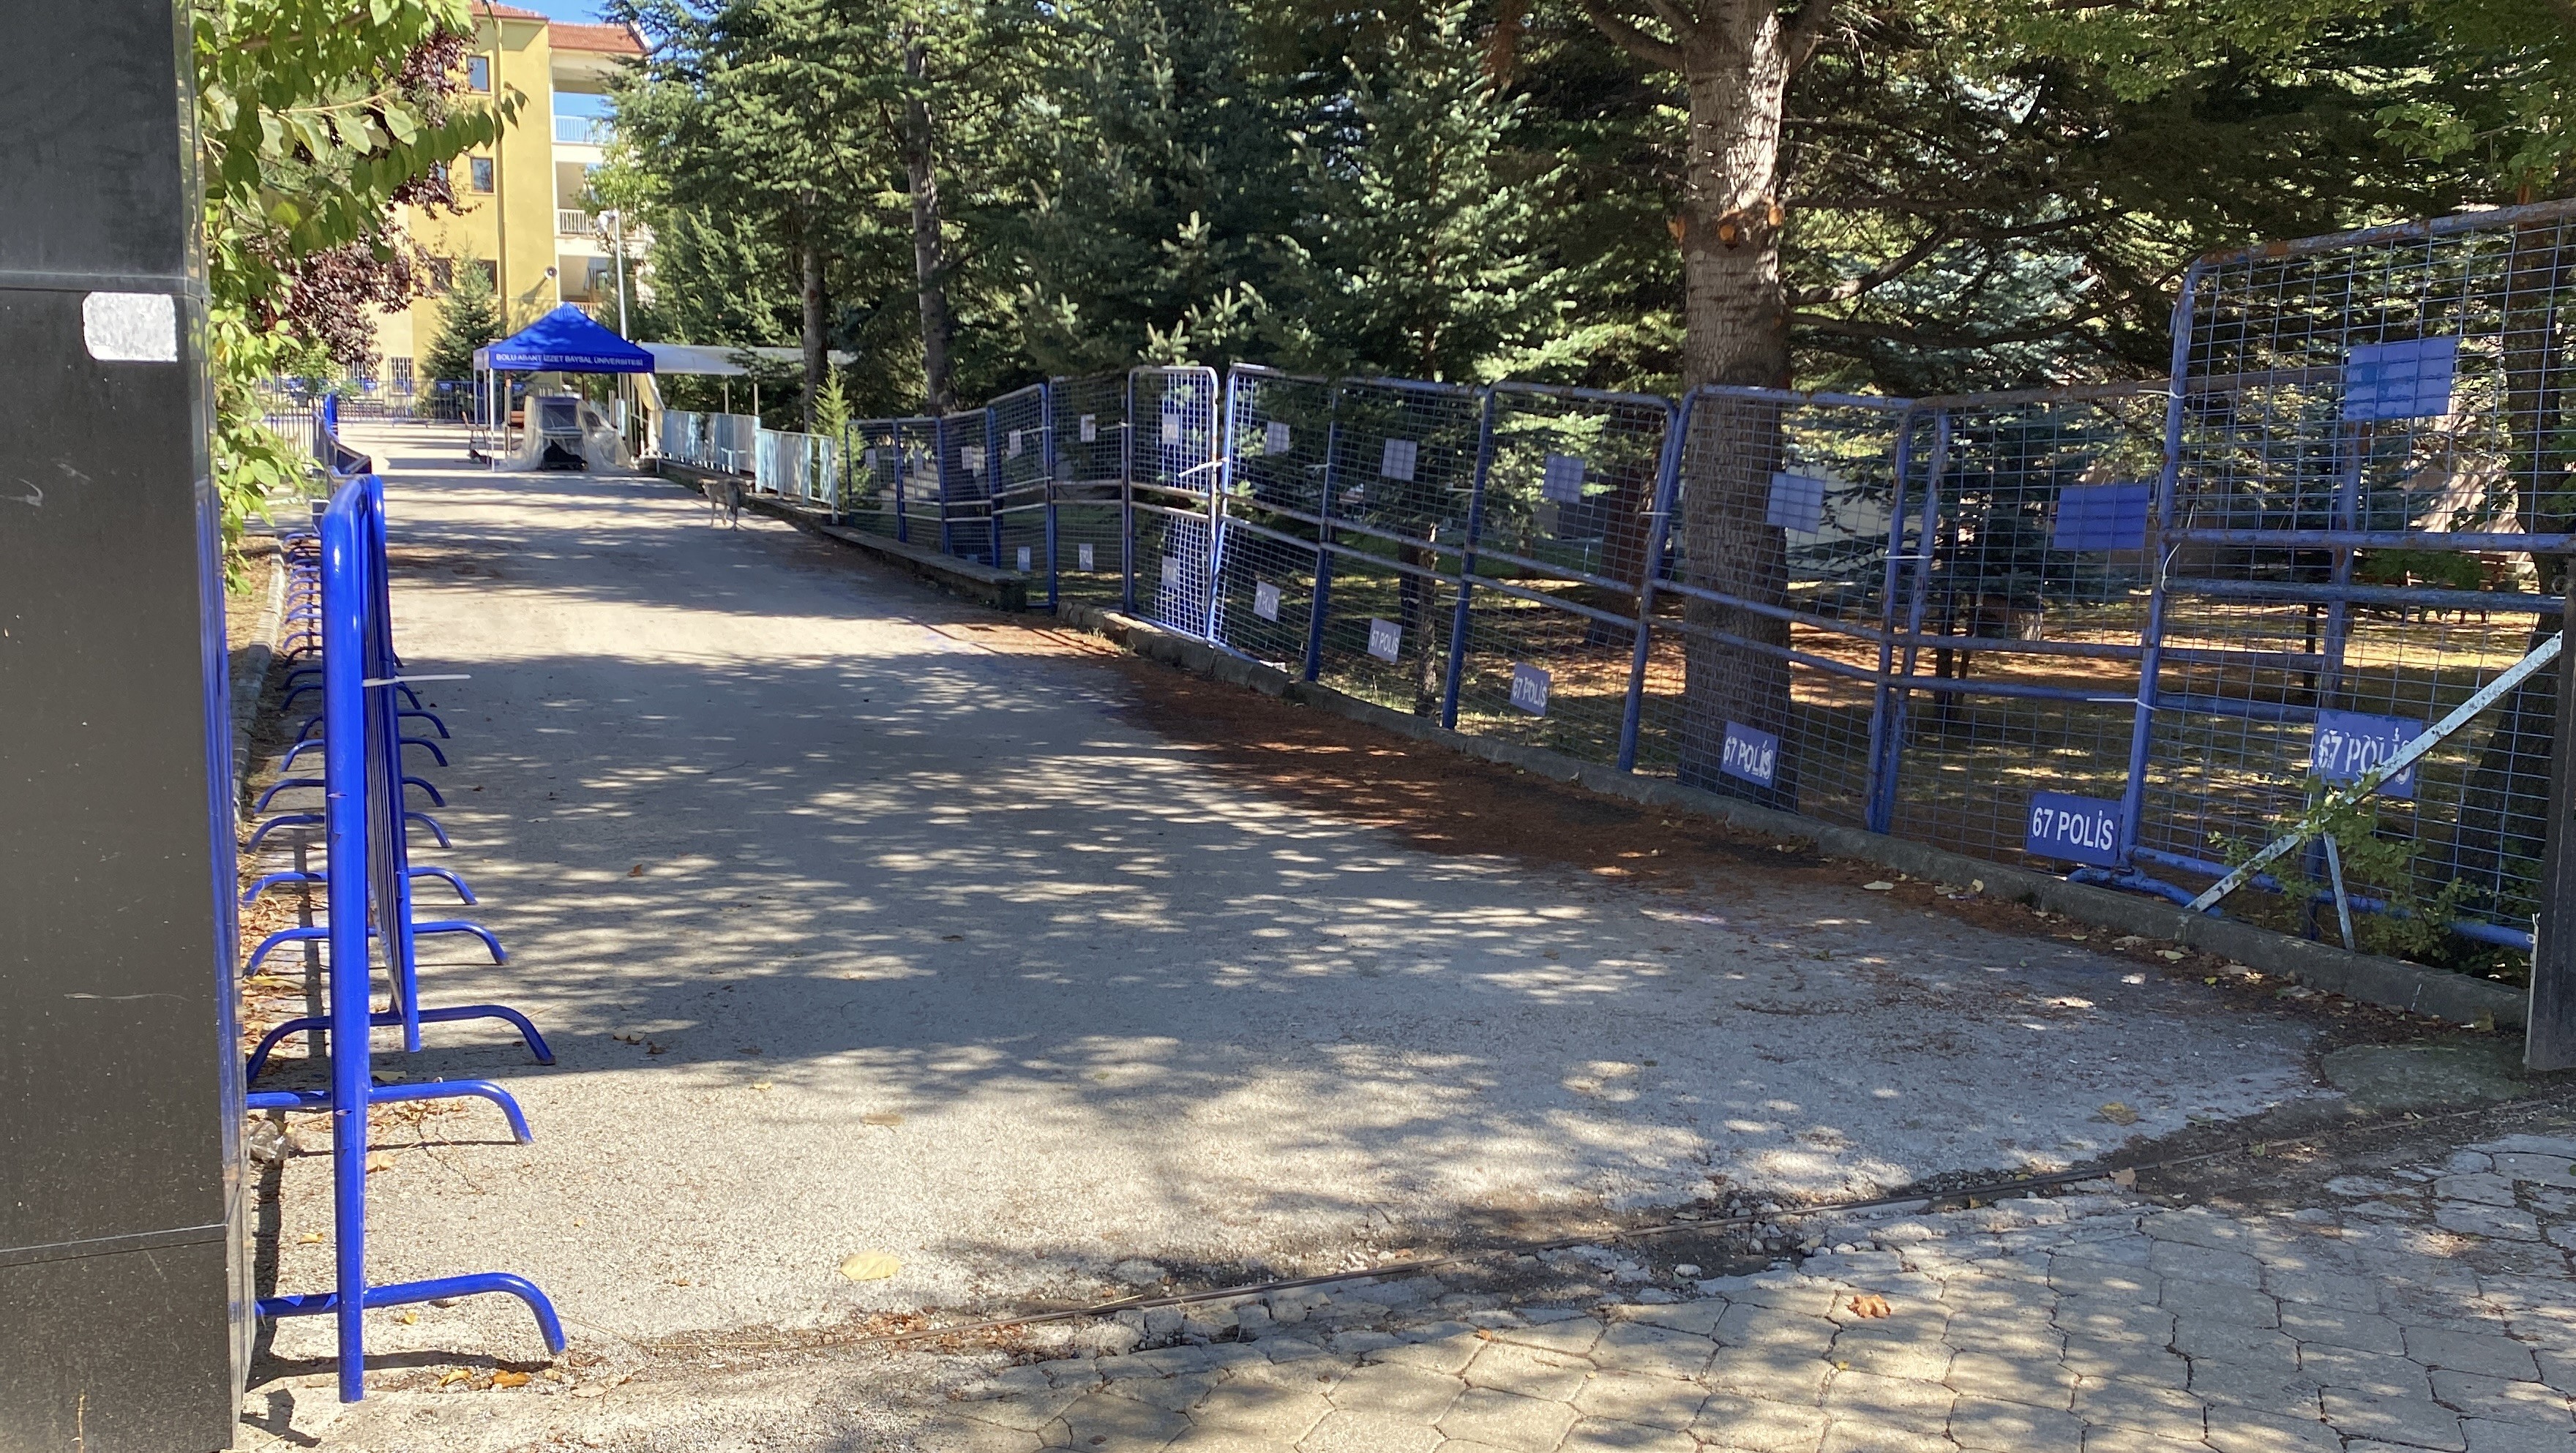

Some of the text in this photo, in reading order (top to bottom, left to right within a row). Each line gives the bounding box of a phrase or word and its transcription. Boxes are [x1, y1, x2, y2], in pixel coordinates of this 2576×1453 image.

[495, 353, 517, 361] BOLU
[517, 354, 542, 362] ABANT
[564, 355, 593, 364] BAYSAL
[1379, 629, 1399, 656] POLİS
[1522, 677, 1547, 708] POLİS
[1723, 735, 1773, 780] 67 POLİS
[2318, 728, 2343, 770] 67
[2032, 807, 2114, 851] 67 POLİS
